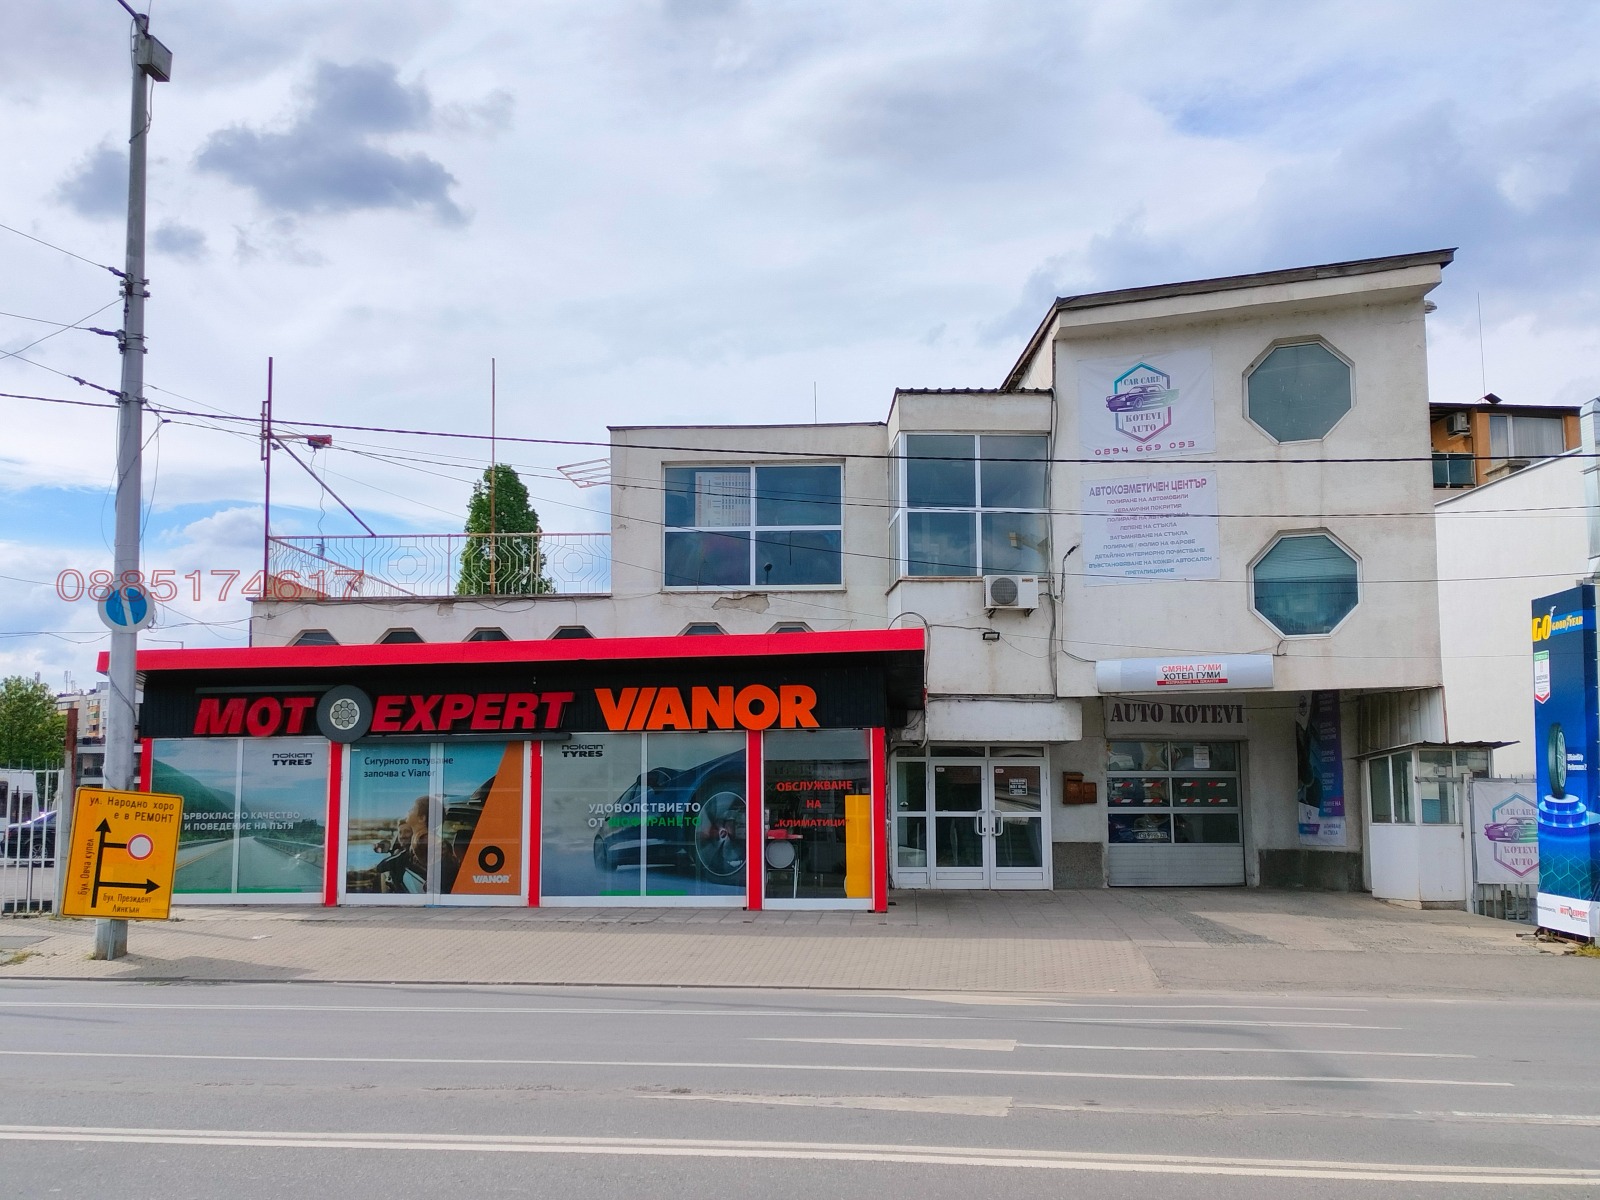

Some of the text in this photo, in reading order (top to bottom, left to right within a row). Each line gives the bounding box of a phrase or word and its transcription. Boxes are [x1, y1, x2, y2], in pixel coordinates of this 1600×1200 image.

[1124, 376, 1161, 386] CAR CARE
[1126, 412, 1161, 422] KOTEVI
[1131, 424, 1156, 433] AUTO
[1095, 440, 1195, 456] 0894 669 093
[1089, 478, 1207, 497] АВТОКОЗМЕТИЧЕН ЦЕНТЪР
[1148, 494, 1189, 502] АВТОМОБИЛИ
[1532, 614, 1552, 642] GO
[1162, 664, 1222, 673] СМЯНА ГУМИ
[1163, 671, 1221, 680] ХОТЕЛ ГУМИ
[370, 691, 574, 732] EXPERT
[594, 684, 820, 731] VIANOR
[1110, 703, 1244, 724] AUTO KOTEVI
[562, 750, 603, 758] TYRES
[364, 756, 454, 767] Сигурното пътуване
[364, 770, 399, 778] започва
[408, 768, 436, 778] Vianor
[776, 780, 853, 792] ОБСЛУЖВАНЕ
[89, 796, 175, 812] ул. Народно хоро
[588, 802, 701, 814] УДОВОЛСТВИЕТО
[806, 800, 822, 808] НА
[183, 811, 300, 820] ЪРВОКЛАСНО КАЧЕСТВО
[1500, 808, 1536, 816] CAR CARE
[114, 812, 174, 823] е в РЕМОНТ
[588, 816, 701, 828] ОТ ШОФИРАНЕТО
[184, 822, 294, 832] И ПОВЕДЕНИЕ НА ПЪТЯ
[84, 838, 96, 860] купел
[1504, 846, 1538, 854] KOTEVI
[1510, 858, 1534, 866] AUTO
[80, 861, 92, 879] Овча
[472, 875, 510, 884] VIANOR
[117, 894, 152, 904] Президент
[112, 904, 140, 914] Линкълн
